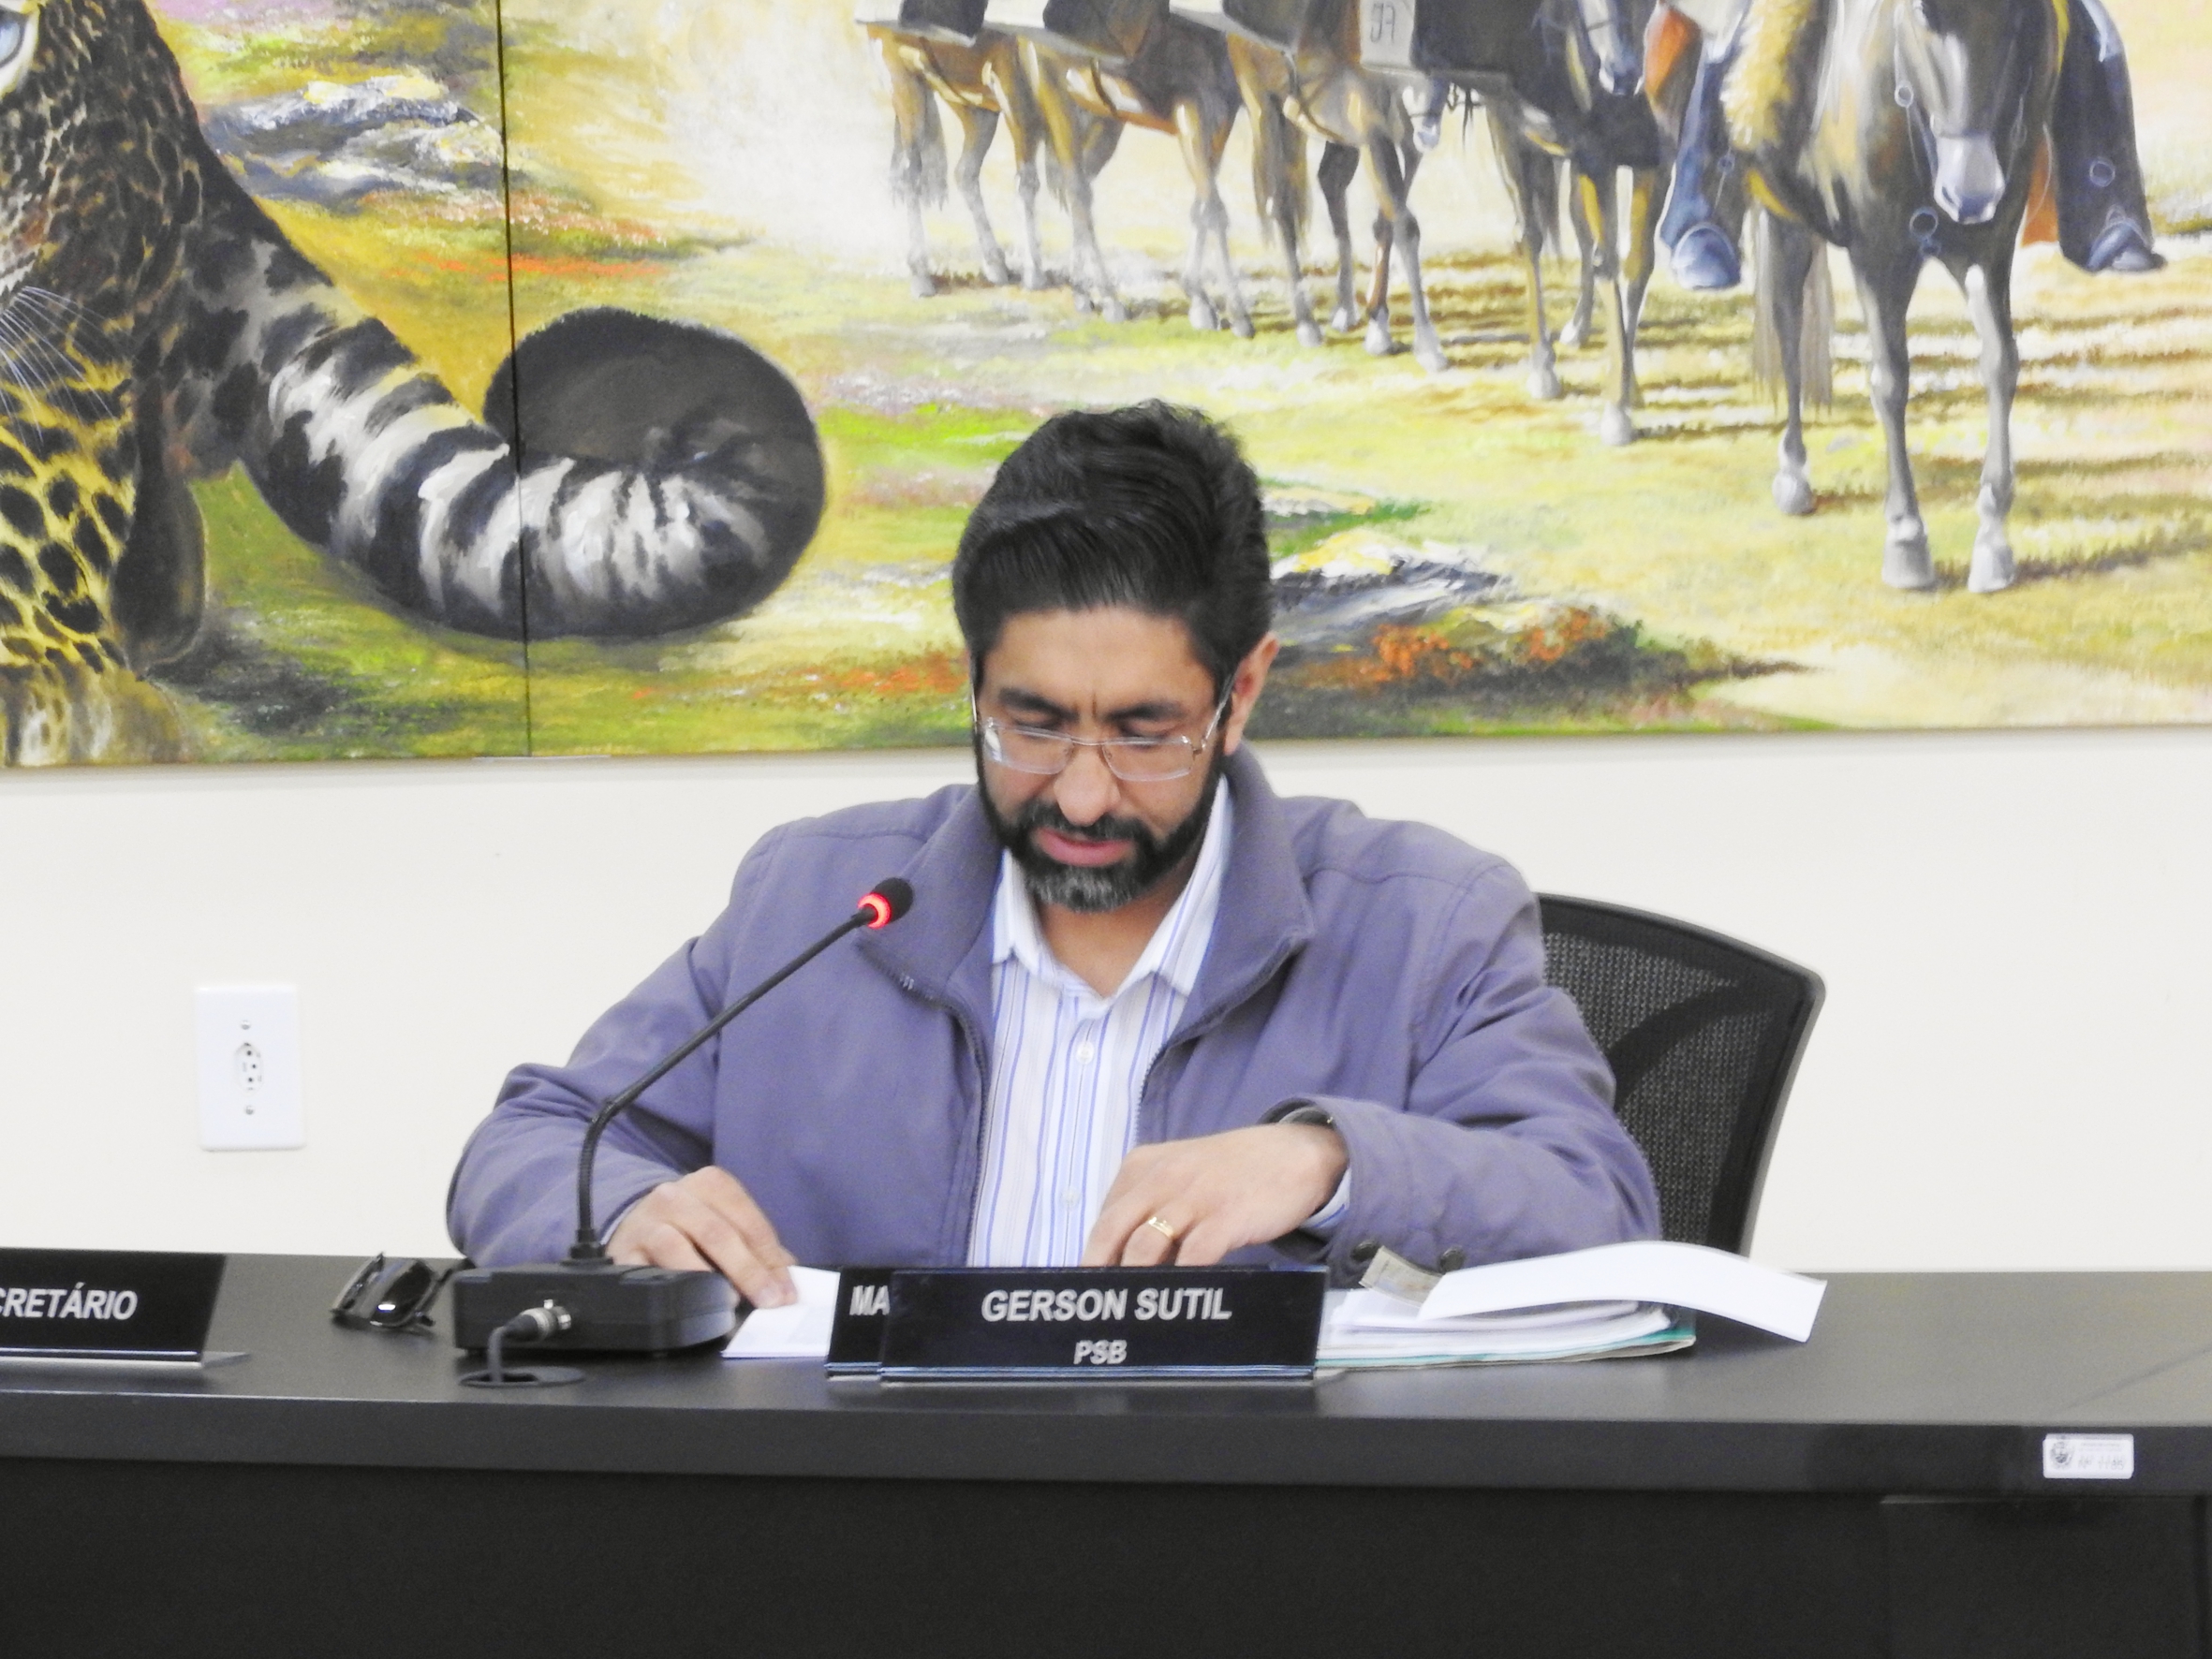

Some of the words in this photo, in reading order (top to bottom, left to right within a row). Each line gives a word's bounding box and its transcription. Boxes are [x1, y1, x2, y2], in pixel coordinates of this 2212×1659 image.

[981, 1289, 1128, 1322] GERSON
[1134, 1288, 1232, 1321] SUTIL
[1073, 1340, 1128, 1365] PSB
